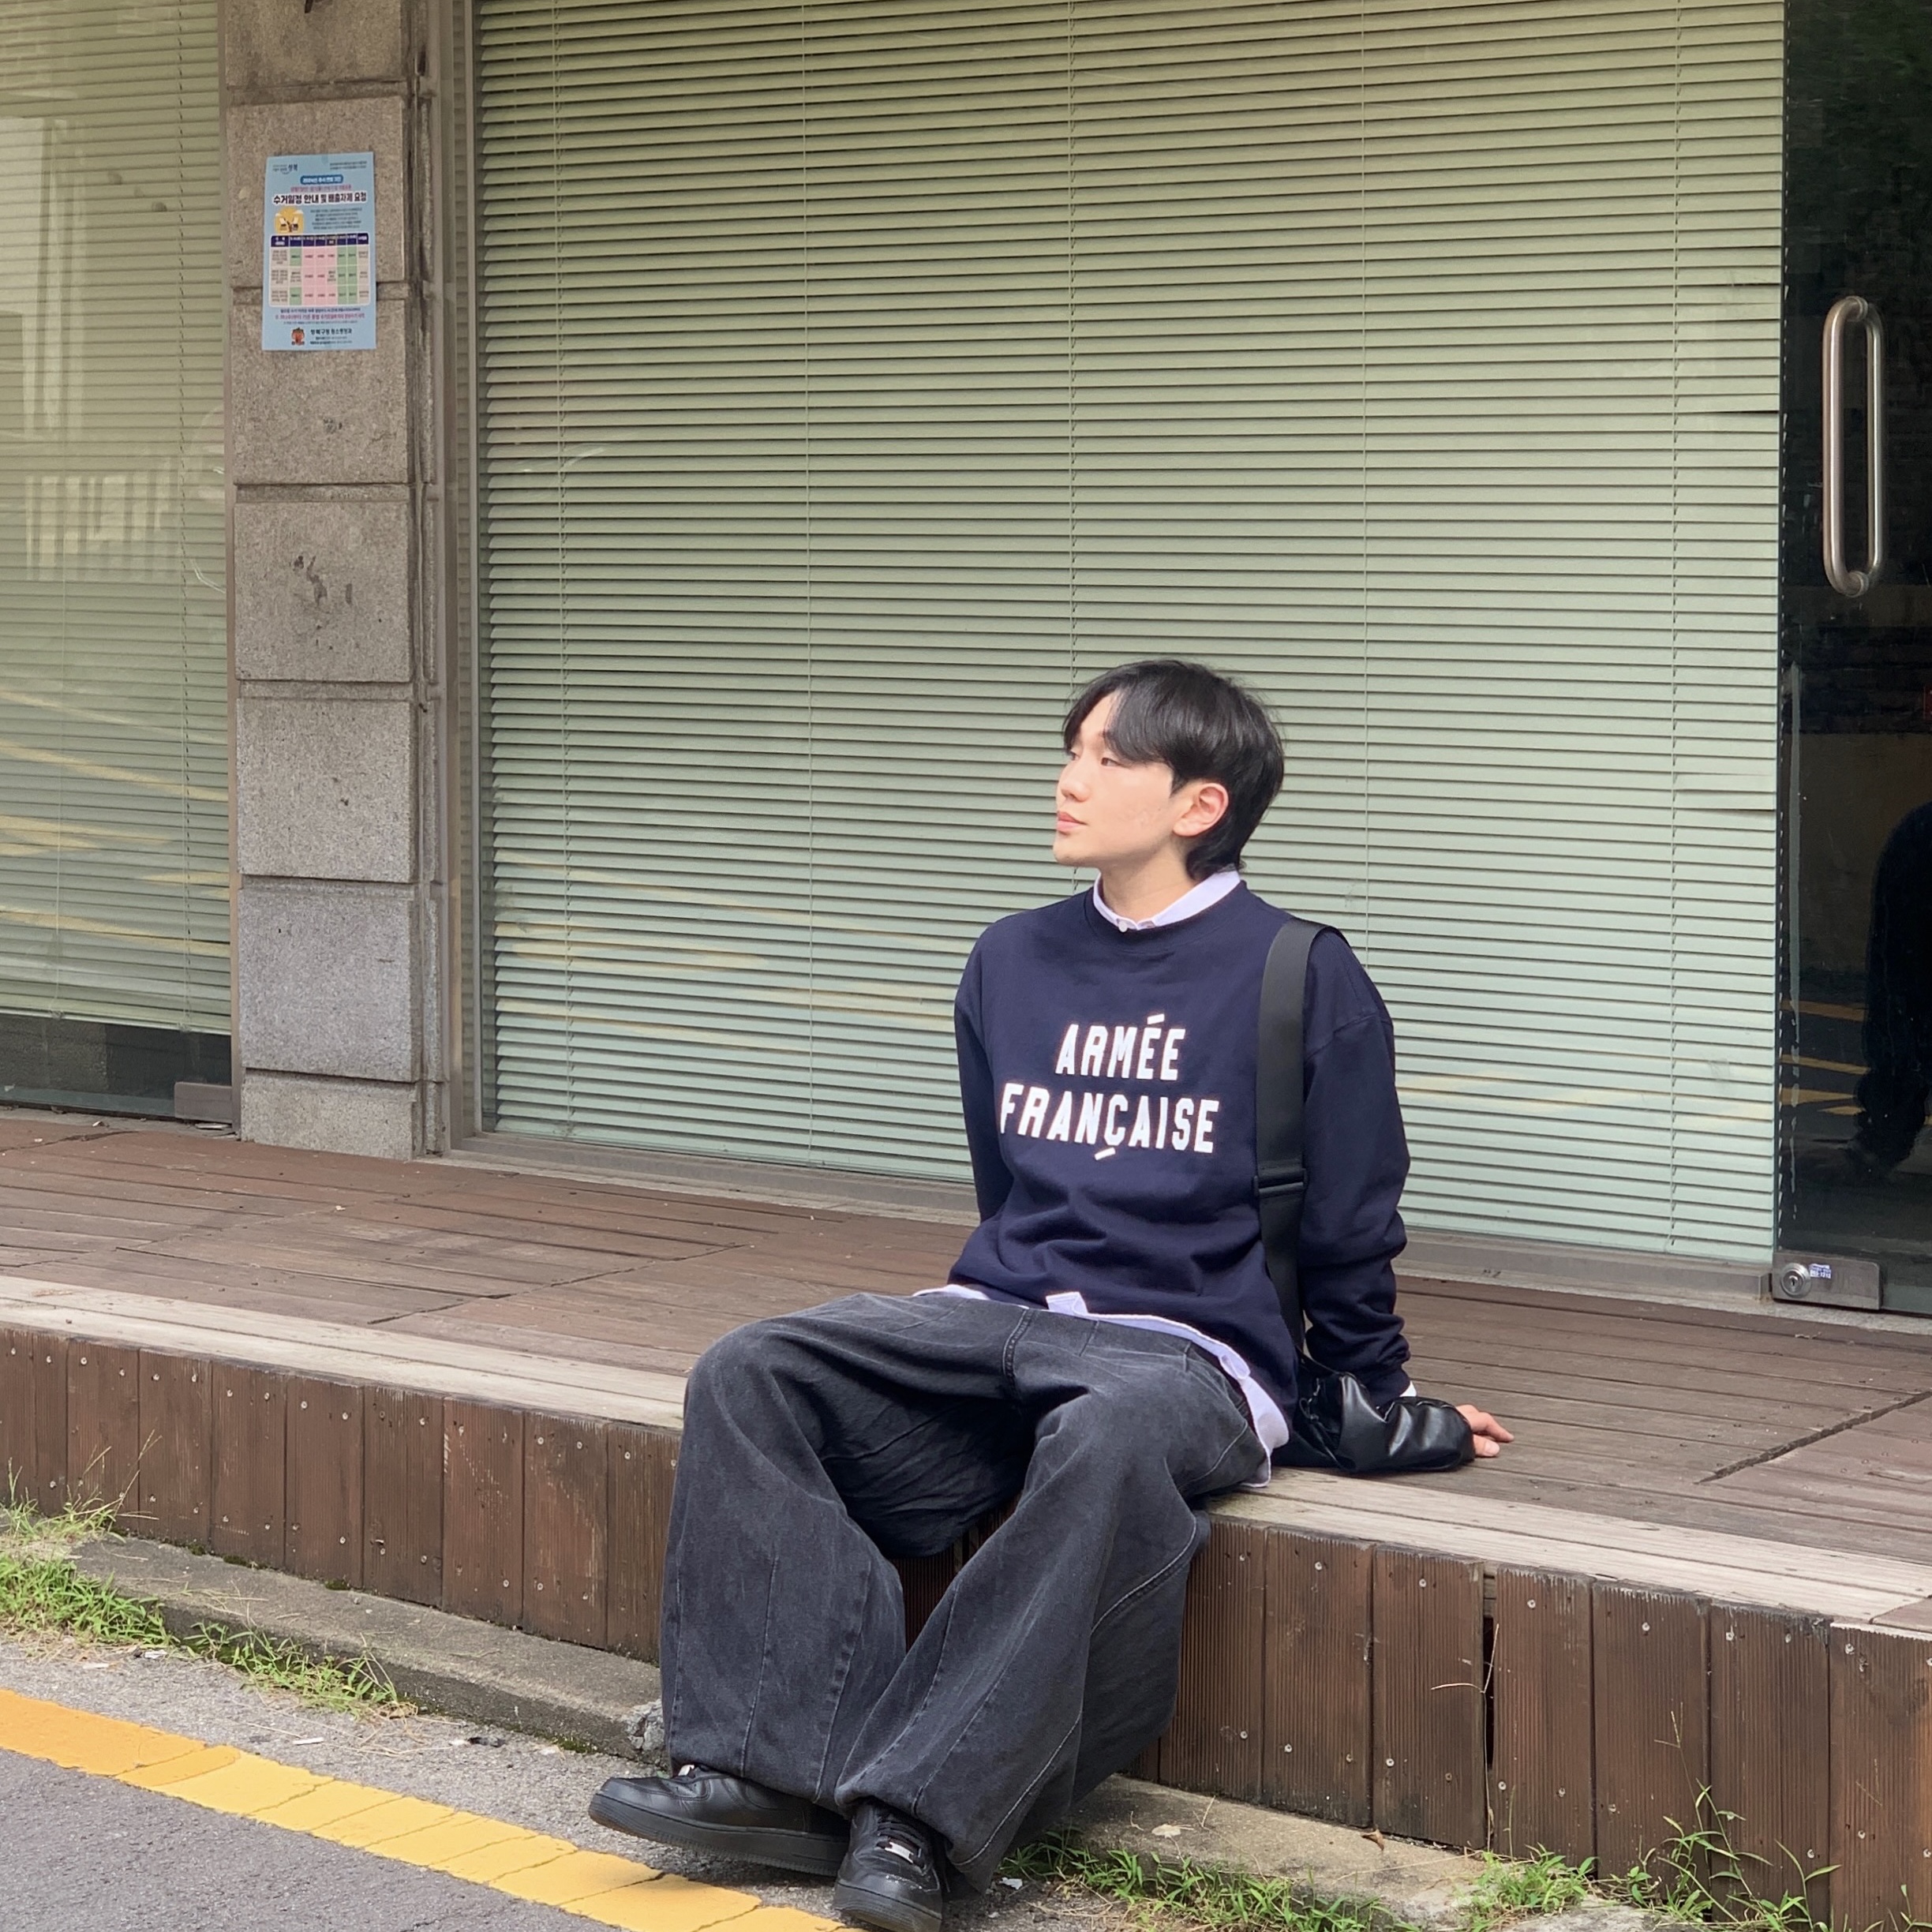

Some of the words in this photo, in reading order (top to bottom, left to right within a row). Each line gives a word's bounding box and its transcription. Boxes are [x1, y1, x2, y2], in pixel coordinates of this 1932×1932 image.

[274, 194, 302, 204] 수거일정
[304, 193, 319, 204] 안내
[320, 193, 328, 204] 및
[354, 192, 367, 202] 요청
[1055, 1013, 1185, 1081] ARMÉE
[1000, 1083, 1219, 1160] FRANÇAISE
